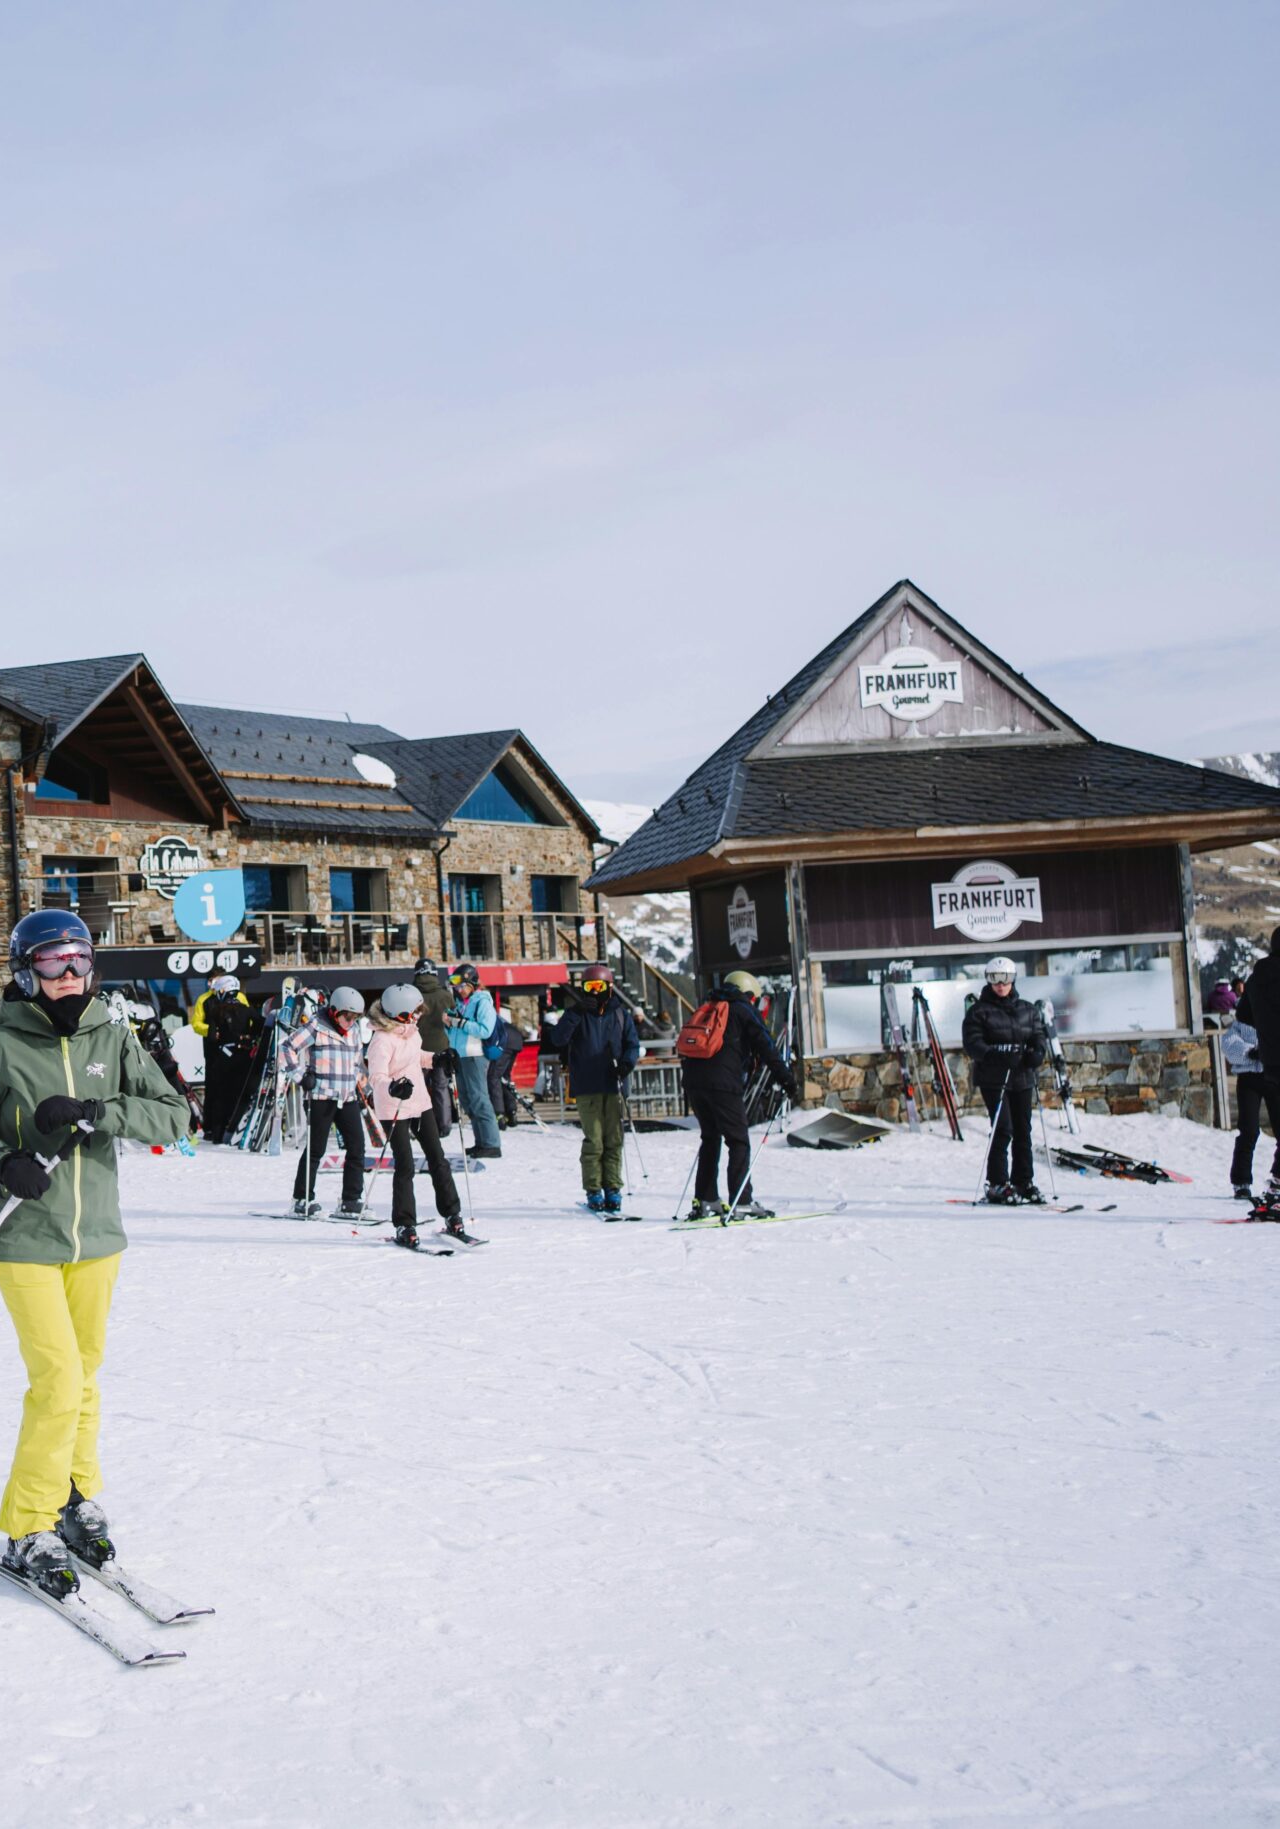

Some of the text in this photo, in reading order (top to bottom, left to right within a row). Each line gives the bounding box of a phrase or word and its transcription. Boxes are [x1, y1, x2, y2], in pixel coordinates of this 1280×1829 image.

[865, 671, 958, 695] FRANKFURT
[892, 692, 930, 709] Gourmet
[938, 888, 1036, 915] FRANKFURT
[966, 911, 1008, 929] Gourmet
